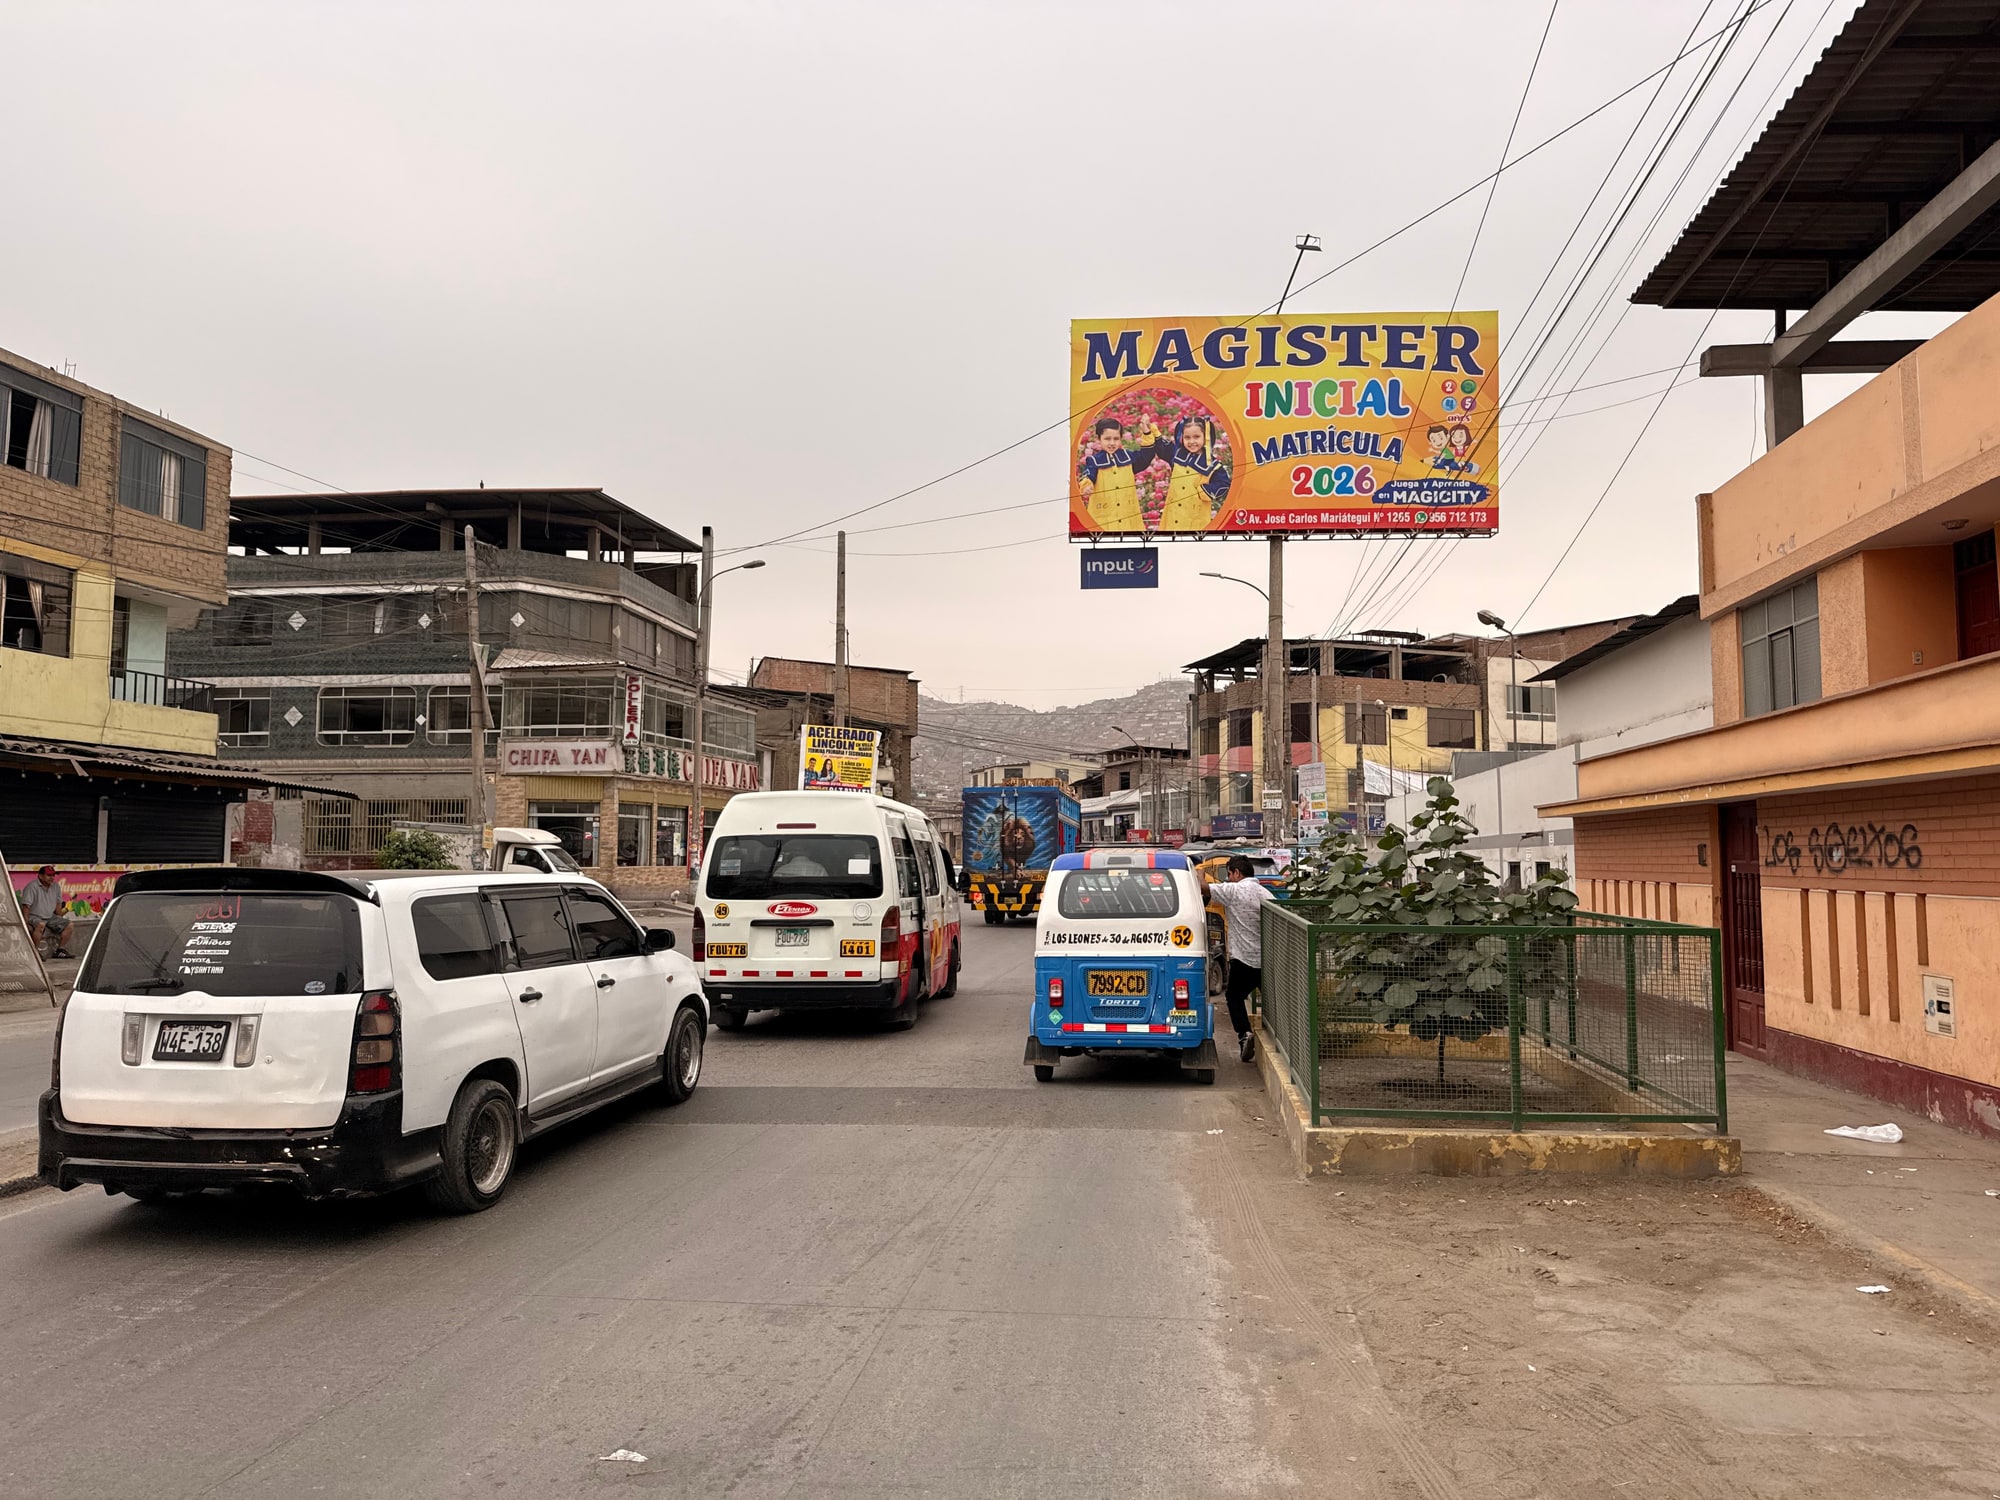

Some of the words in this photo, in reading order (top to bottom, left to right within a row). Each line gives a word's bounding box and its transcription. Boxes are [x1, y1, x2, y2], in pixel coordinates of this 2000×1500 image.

[1081, 325, 1484, 382] MAGISTER
[1445, 381, 1453, 392] 2
[1246, 379, 1409, 417] INICIAL
[1445, 399, 1454, 409] 4
[1464, 398, 1472, 409] 5
[1252, 425, 1403, 465] MATRÍCULA
[1293, 465, 1376, 496] 2026
[1391, 480, 1419, 489] Juega
[1423, 481, 1428, 489] y
[1432, 480, 1471, 489] Aprende
[1393, 490, 1481, 503] MAGICITY
[1249, 513, 1262, 524] Av.
[1265, 512, 1286, 524] José
[1288, 512, 1318, 524] Carlos
[1320, 511, 1371, 525] Mariátegui
[1429, 511, 1447, 523] 956
[1449, 511, 1466, 523] 712
[1469, 511, 1487, 523] 173
[1086, 558, 1135, 575] input
[625, 675, 641, 740] POLLERIA
[808, 726, 875, 742] ACELERADO
[812, 738, 855, 751] LINCOLN
[508, 749, 561, 766] CHIFA
[571, 748, 607, 765] YAN
[683, 752, 729, 786] CIFA
[731, 762, 759, 790] YAN
[716, 906, 728, 916] 49
[1051, 933, 1066, 944] LOS
[1068, 933, 1101, 944] LEONES
[1109, 933, 1122, 944] 30
[1130, 932, 1164, 944] AGOSTO
[1173, 928, 1192, 946] 52
[843, 945, 870, 955] 1401
[1091, 974, 1146, 994] 7992-CD
[1171, 1015, 1196, 1024] 7992-CD
[160, 1031, 223, 1053] W4E-138
